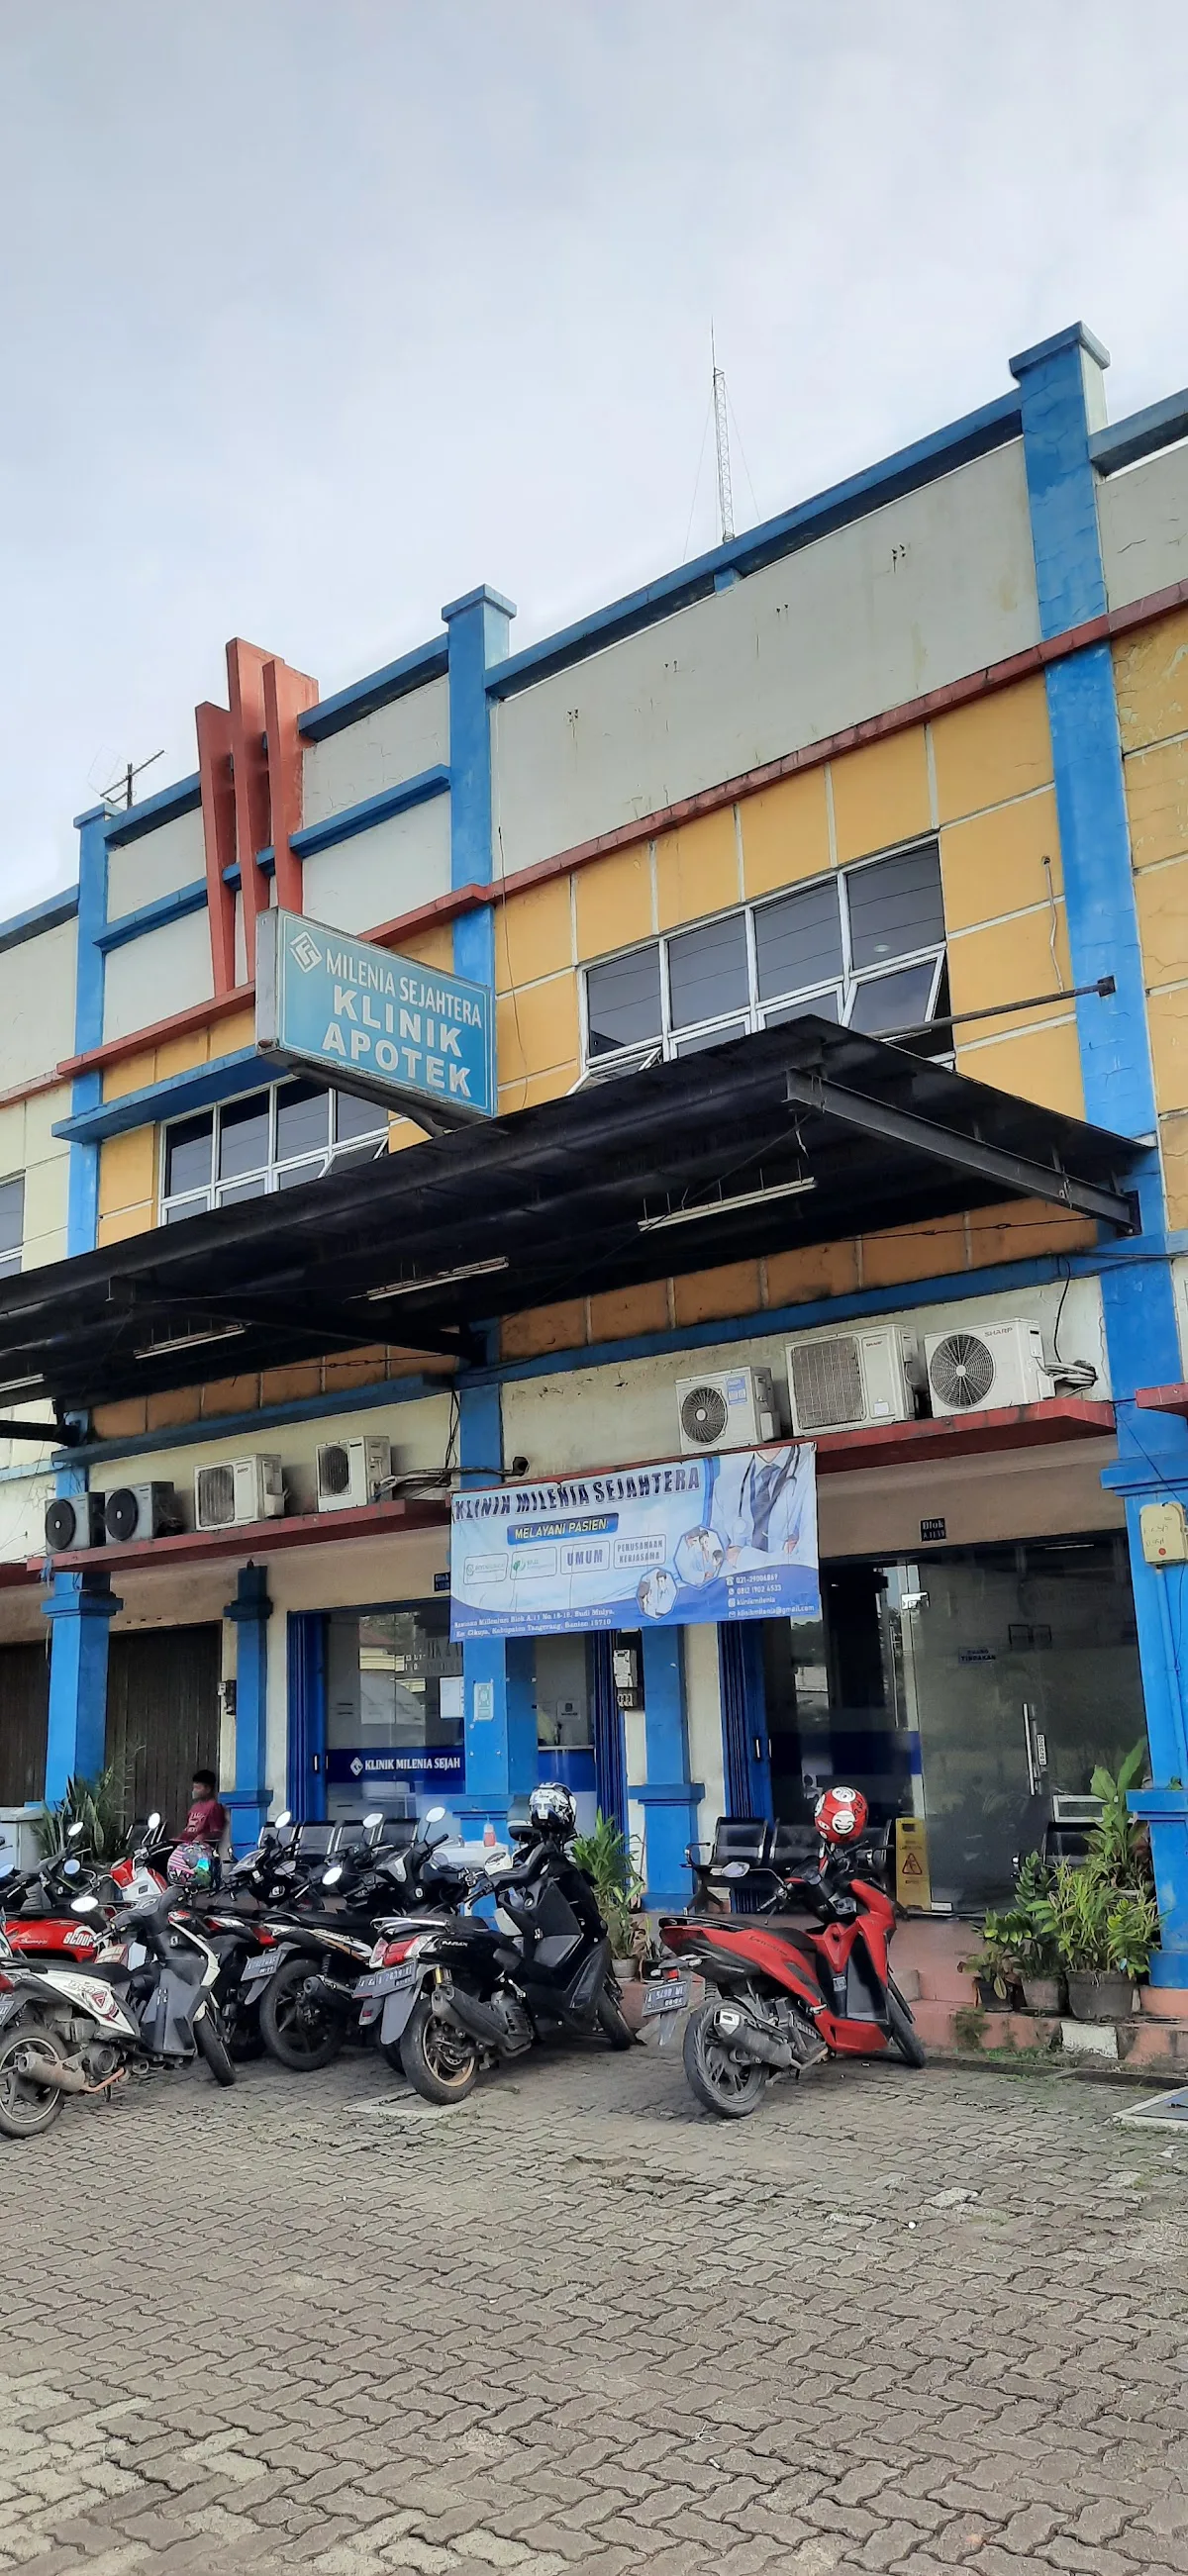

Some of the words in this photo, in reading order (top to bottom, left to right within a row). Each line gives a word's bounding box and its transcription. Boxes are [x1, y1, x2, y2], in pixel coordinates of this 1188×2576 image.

[326, 948, 395, 997] MILENIA
[399, 976, 482, 1029] SEJAHTERA
[334, 984, 462, 1058] KLINIK
[322, 1021, 471, 1097] APOTEK
[516, 1483, 590, 1513] MILENIA
[593, 1467, 700, 1503] SEJAHTERA
[515, 1523, 566, 1540] MELAYANI
[617, 1540, 663, 1553] PERUSAHAAN
[566, 1549, 603, 1567] UMUM
[619, 1551, 660, 1564] KERJASAMA
[364, 1760, 395, 1770] KLINIK
[396, 1758, 433, 1769] MILENIA
